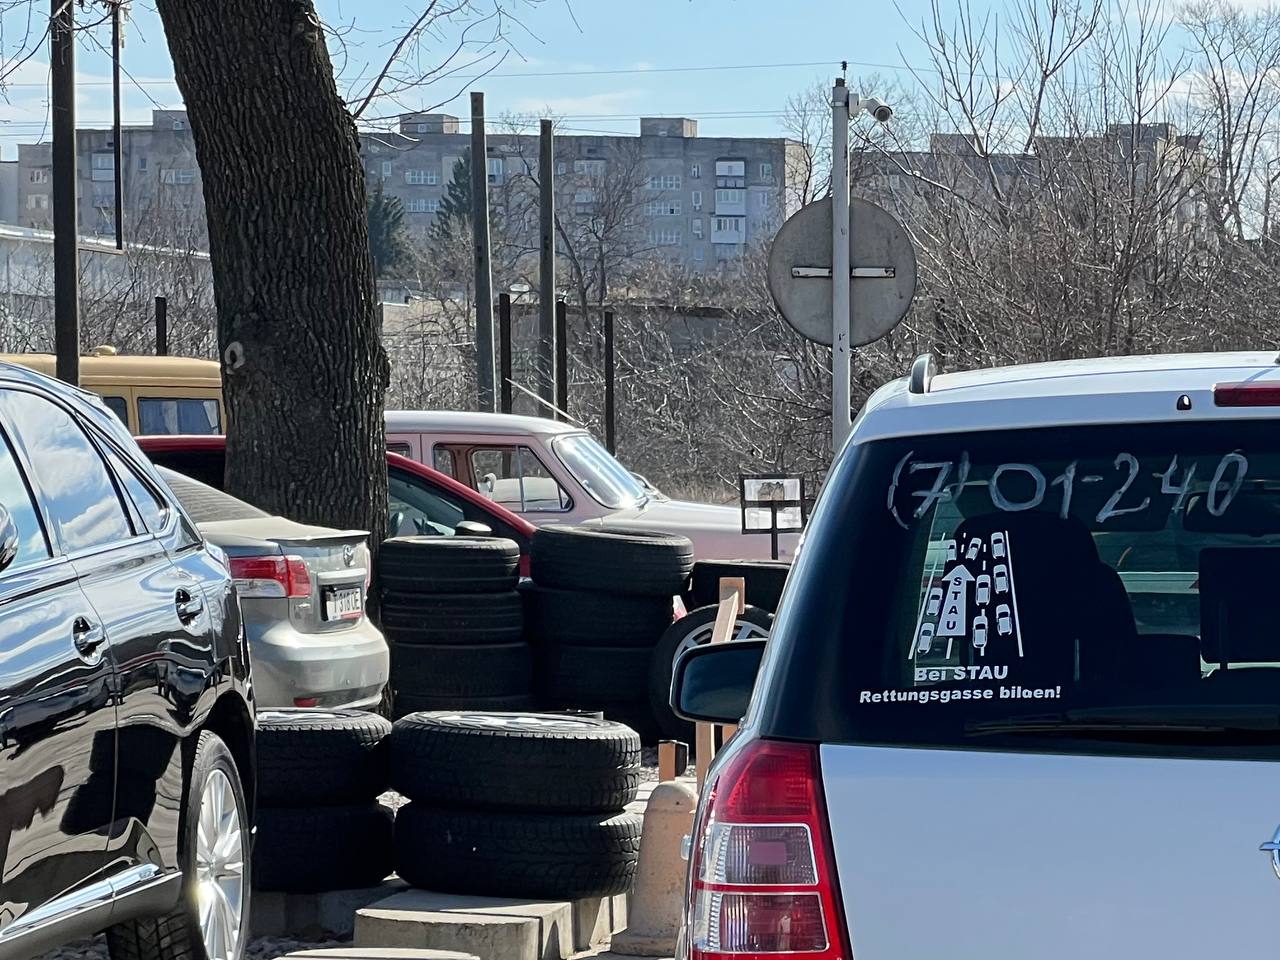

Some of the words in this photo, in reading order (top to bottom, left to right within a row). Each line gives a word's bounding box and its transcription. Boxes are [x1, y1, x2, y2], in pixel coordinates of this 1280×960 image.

[946, 576, 963, 630] STAU
[914, 668, 946, 681] Bei
[953, 665, 1009, 680] STAU
[860, 690, 993, 703] Rettungsgasse
